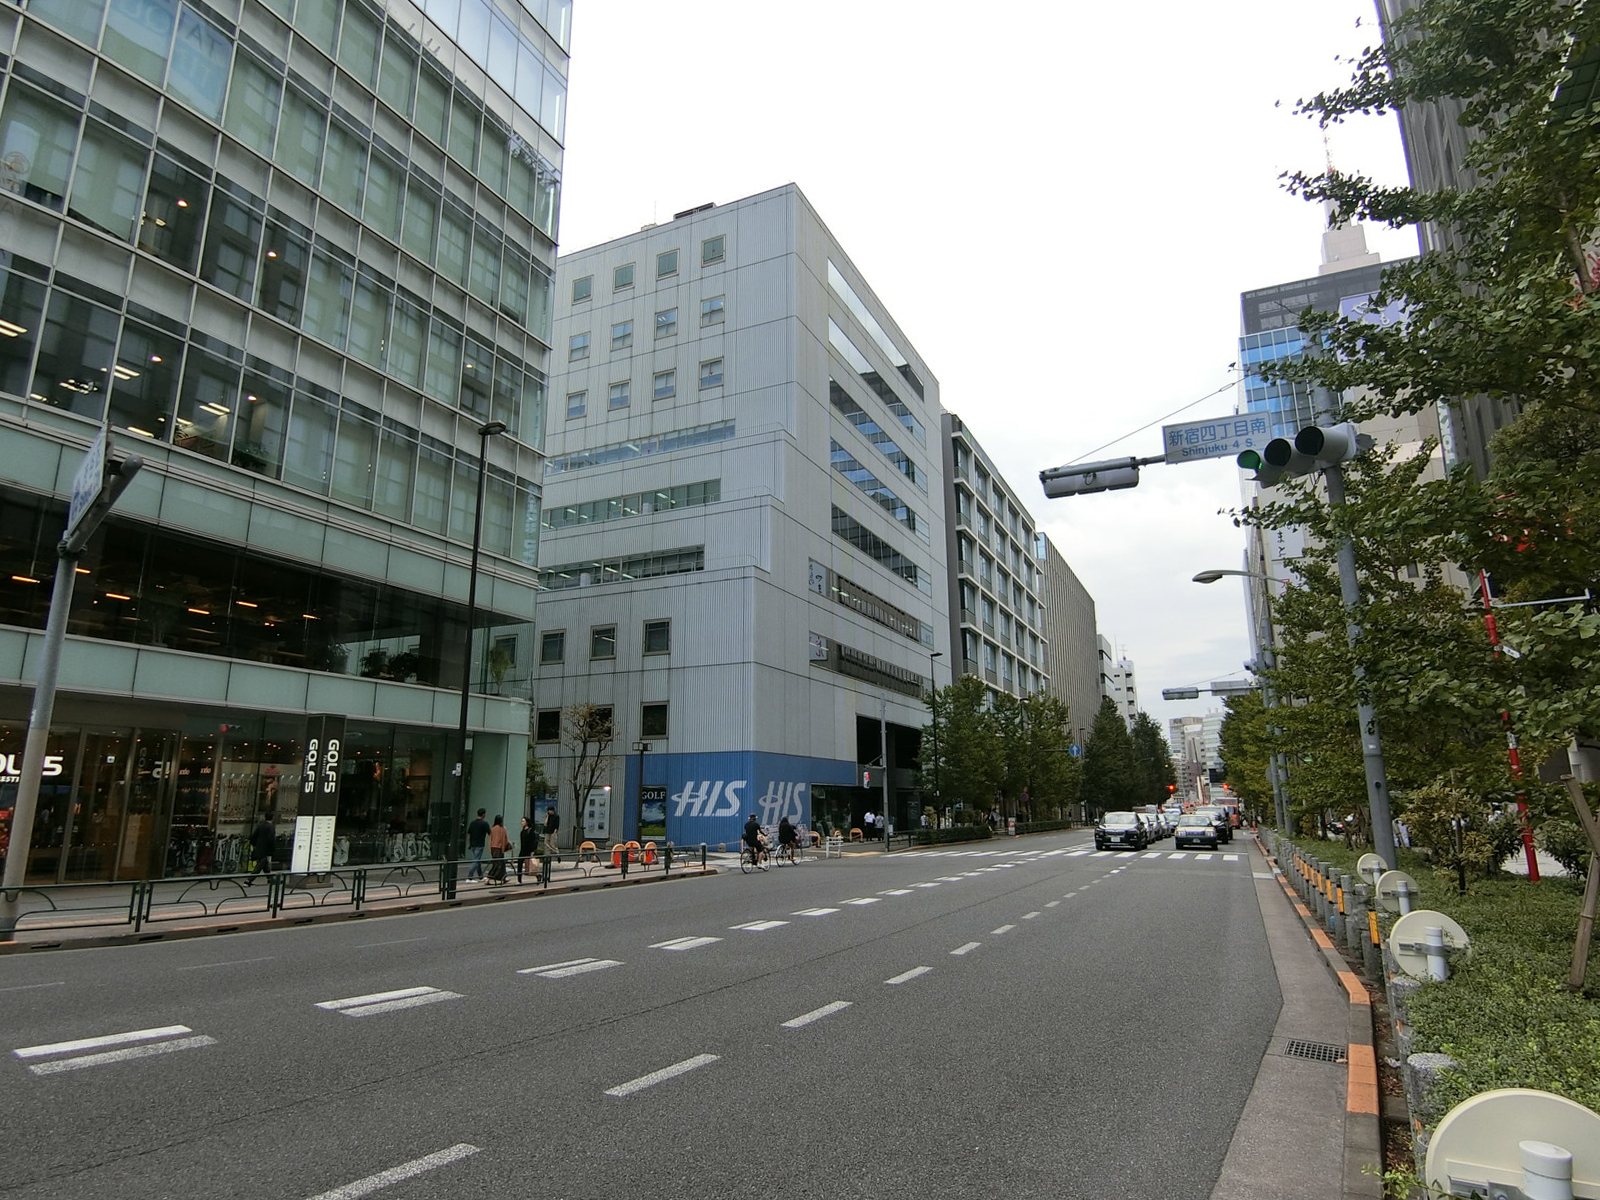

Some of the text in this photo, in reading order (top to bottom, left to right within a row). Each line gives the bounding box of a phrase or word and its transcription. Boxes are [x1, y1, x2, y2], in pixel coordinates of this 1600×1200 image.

[1169, 418, 1267, 447] 新宿四丁目南
[1182, 437, 1256, 457] Shinjuku 4 S.
[641, 791, 665, 800] GOLF
